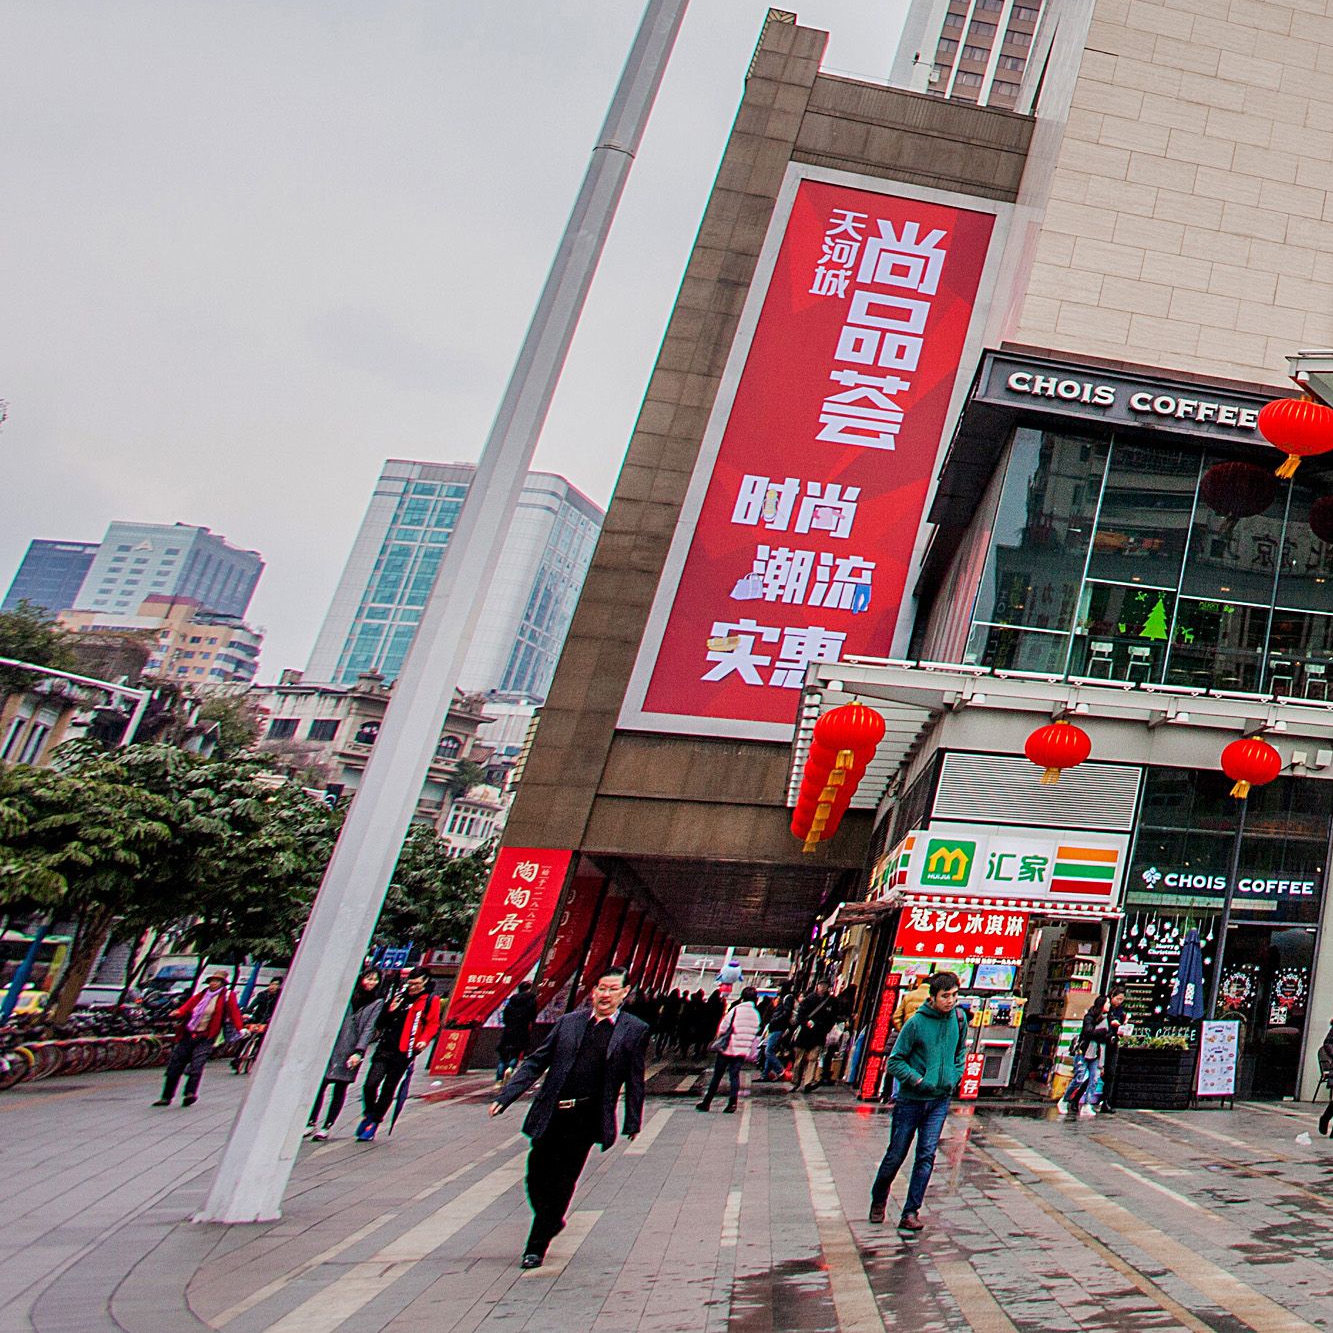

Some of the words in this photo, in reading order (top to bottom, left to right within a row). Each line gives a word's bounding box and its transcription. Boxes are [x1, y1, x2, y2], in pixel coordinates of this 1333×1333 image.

[808, 209, 870, 300] 天河城
[815, 217, 948, 451] 尚品荟
[1006, 371, 1117, 408] CHOIS
[1129, 391, 1258, 430] COFFEE
[731, 474, 861, 539] 时尚
[748, 544, 876, 612] 潮流
[700, 618, 847, 690] 实惠
[488, 860, 540, 936] 陶陶居
[985, 852, 1049, 882] 汇家
[1164, 872, 1226, 890] CHOIS
[1238, 878, 1315, 896] COFFEE
[963, 1062, 982, 1094] 寄存
